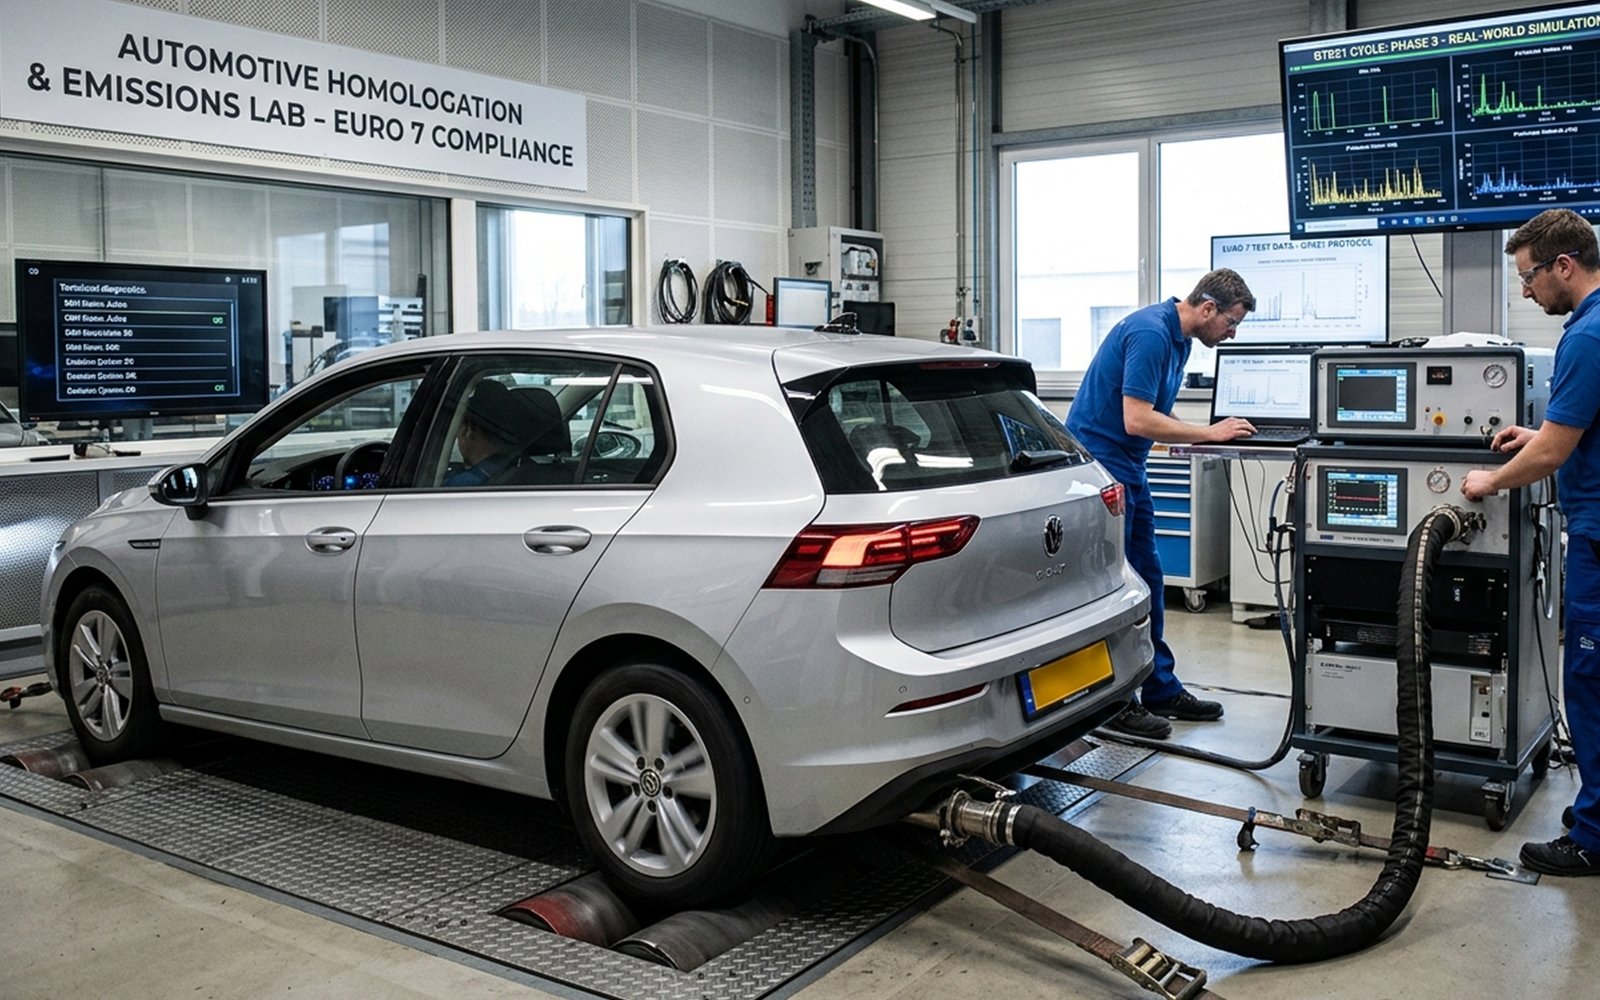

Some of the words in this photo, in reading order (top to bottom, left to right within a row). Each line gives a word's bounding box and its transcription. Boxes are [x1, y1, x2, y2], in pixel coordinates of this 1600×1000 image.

[1391, 37, 1429, 53] PHASE
[1431, 35, 1439, 47] 3
[1448, 25, 1526, 45] REAL-WORLD
[117, 33, 320, 92] AUTOMOTIVE
[328, 69, 524, 126] HOMOLOGATION
[27, 62, 51, 92] &
[63, 66, 241, 119] EMISSIONS
[250, 95, 306, 128] LAB
[334, 109, 404, 142] EURO
[411, 121, 425, 145] 7
[431, 125, 574, 167] COMPLIANCE
[1251, 243, 1271, 252] TEST
